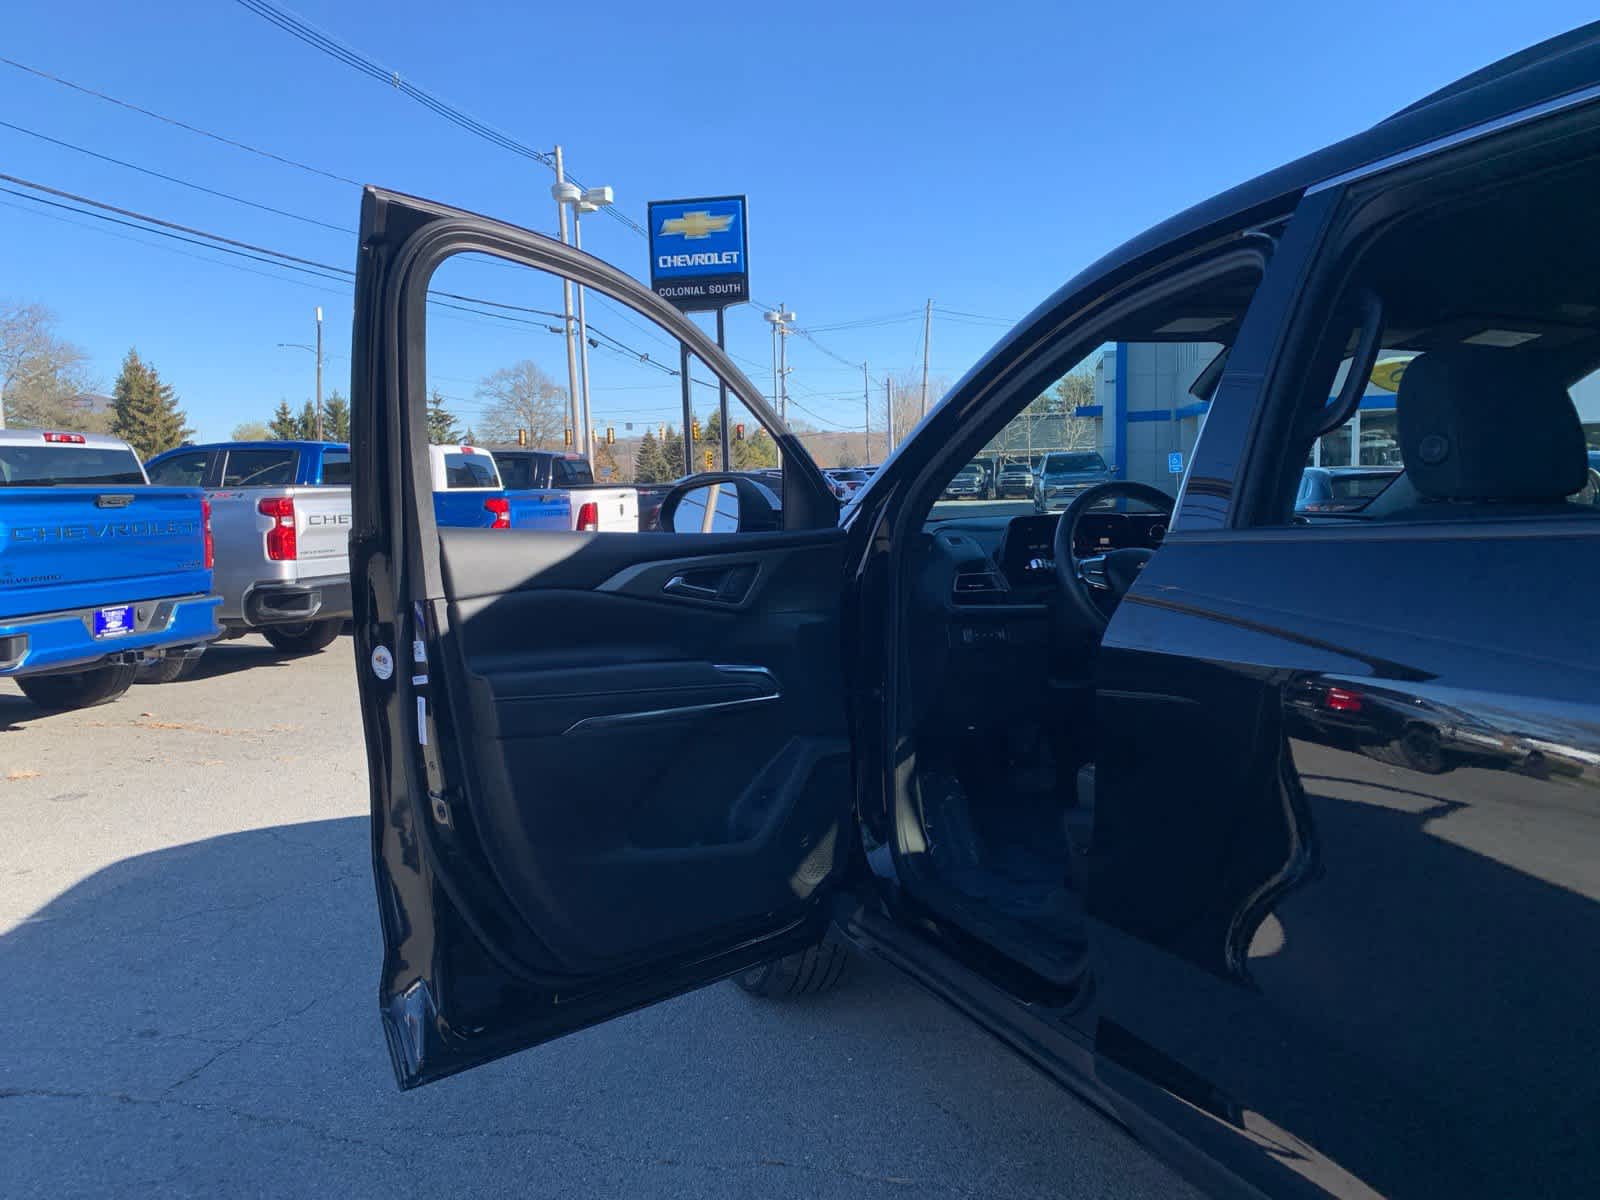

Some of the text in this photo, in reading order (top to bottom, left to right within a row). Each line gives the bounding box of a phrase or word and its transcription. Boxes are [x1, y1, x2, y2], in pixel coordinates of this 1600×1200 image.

[659, 252, 739, 268] CHEVROLET
[659, 284, 740, 297] COLONIAL SOUTH
[13, 520, 194, 542] CHEVROLET
